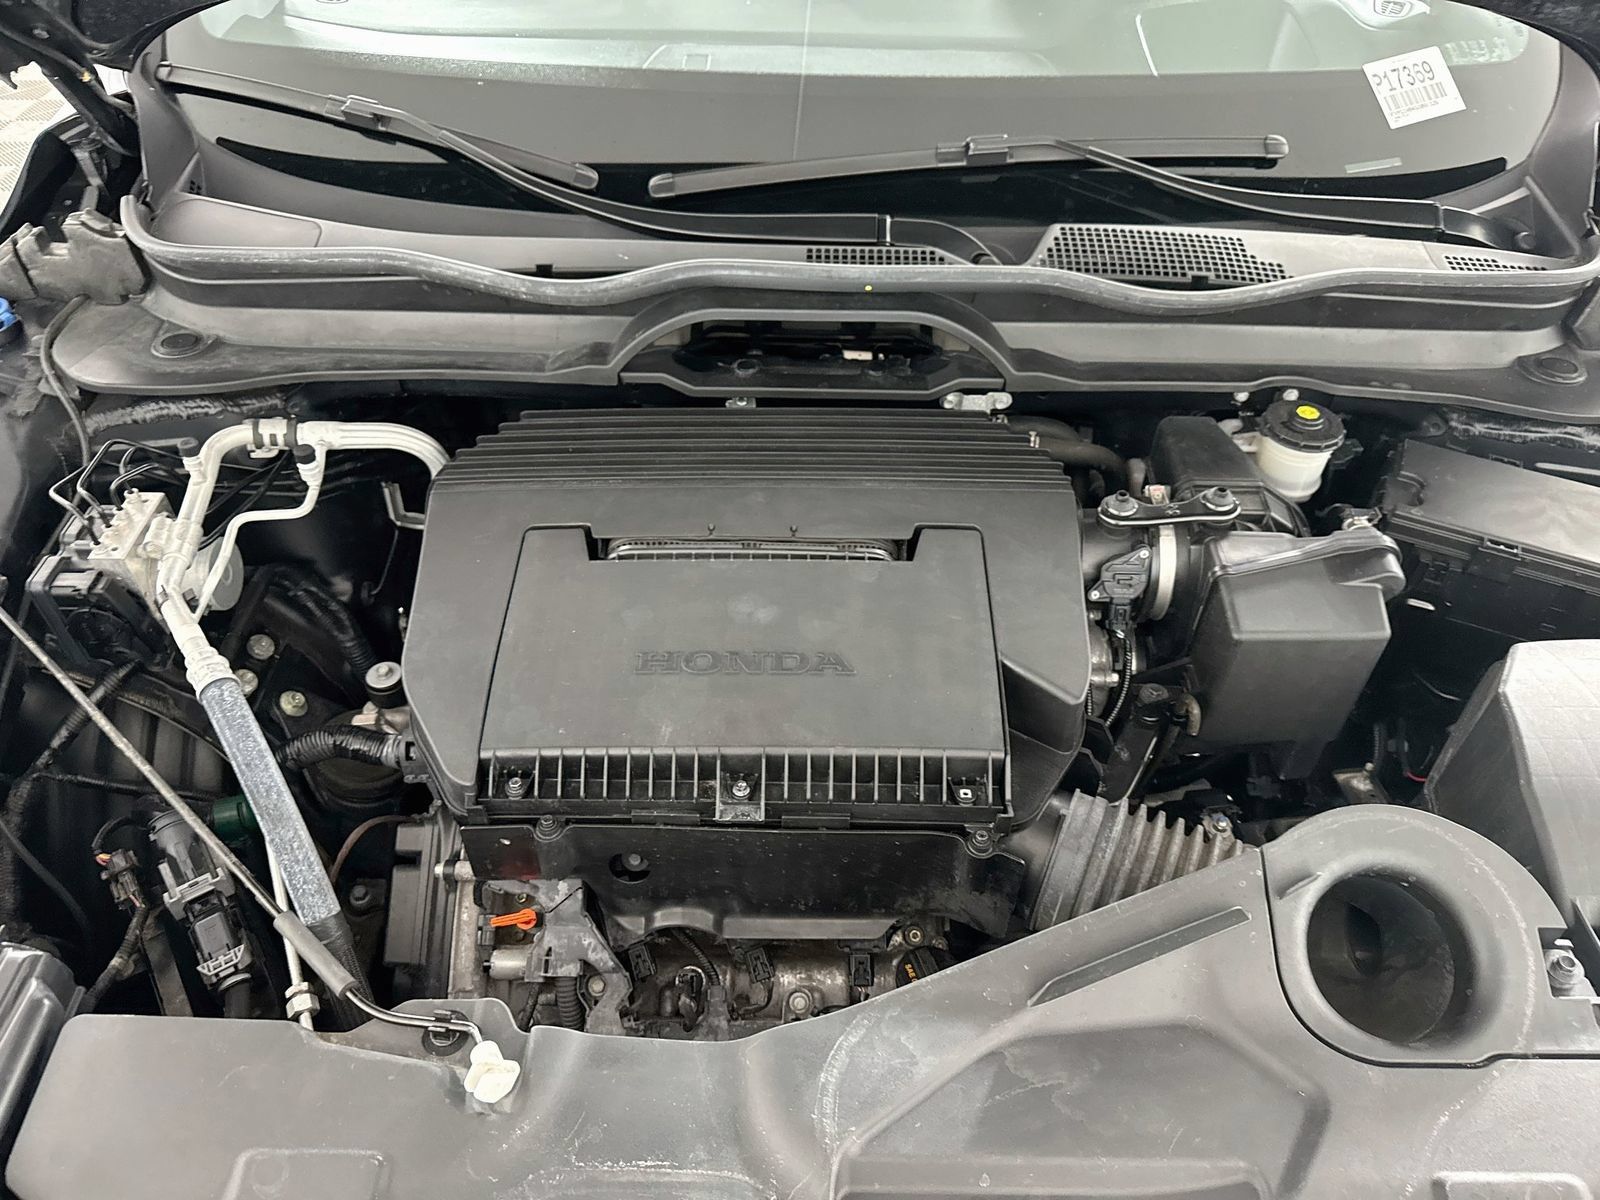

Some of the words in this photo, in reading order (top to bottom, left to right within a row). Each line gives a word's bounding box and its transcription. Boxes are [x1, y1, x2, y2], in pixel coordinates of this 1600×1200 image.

[1371, 60, 1435, 93] P17369
[634, 651, 857, 676] HONDA
[904, 963, 917, 978] SAE
